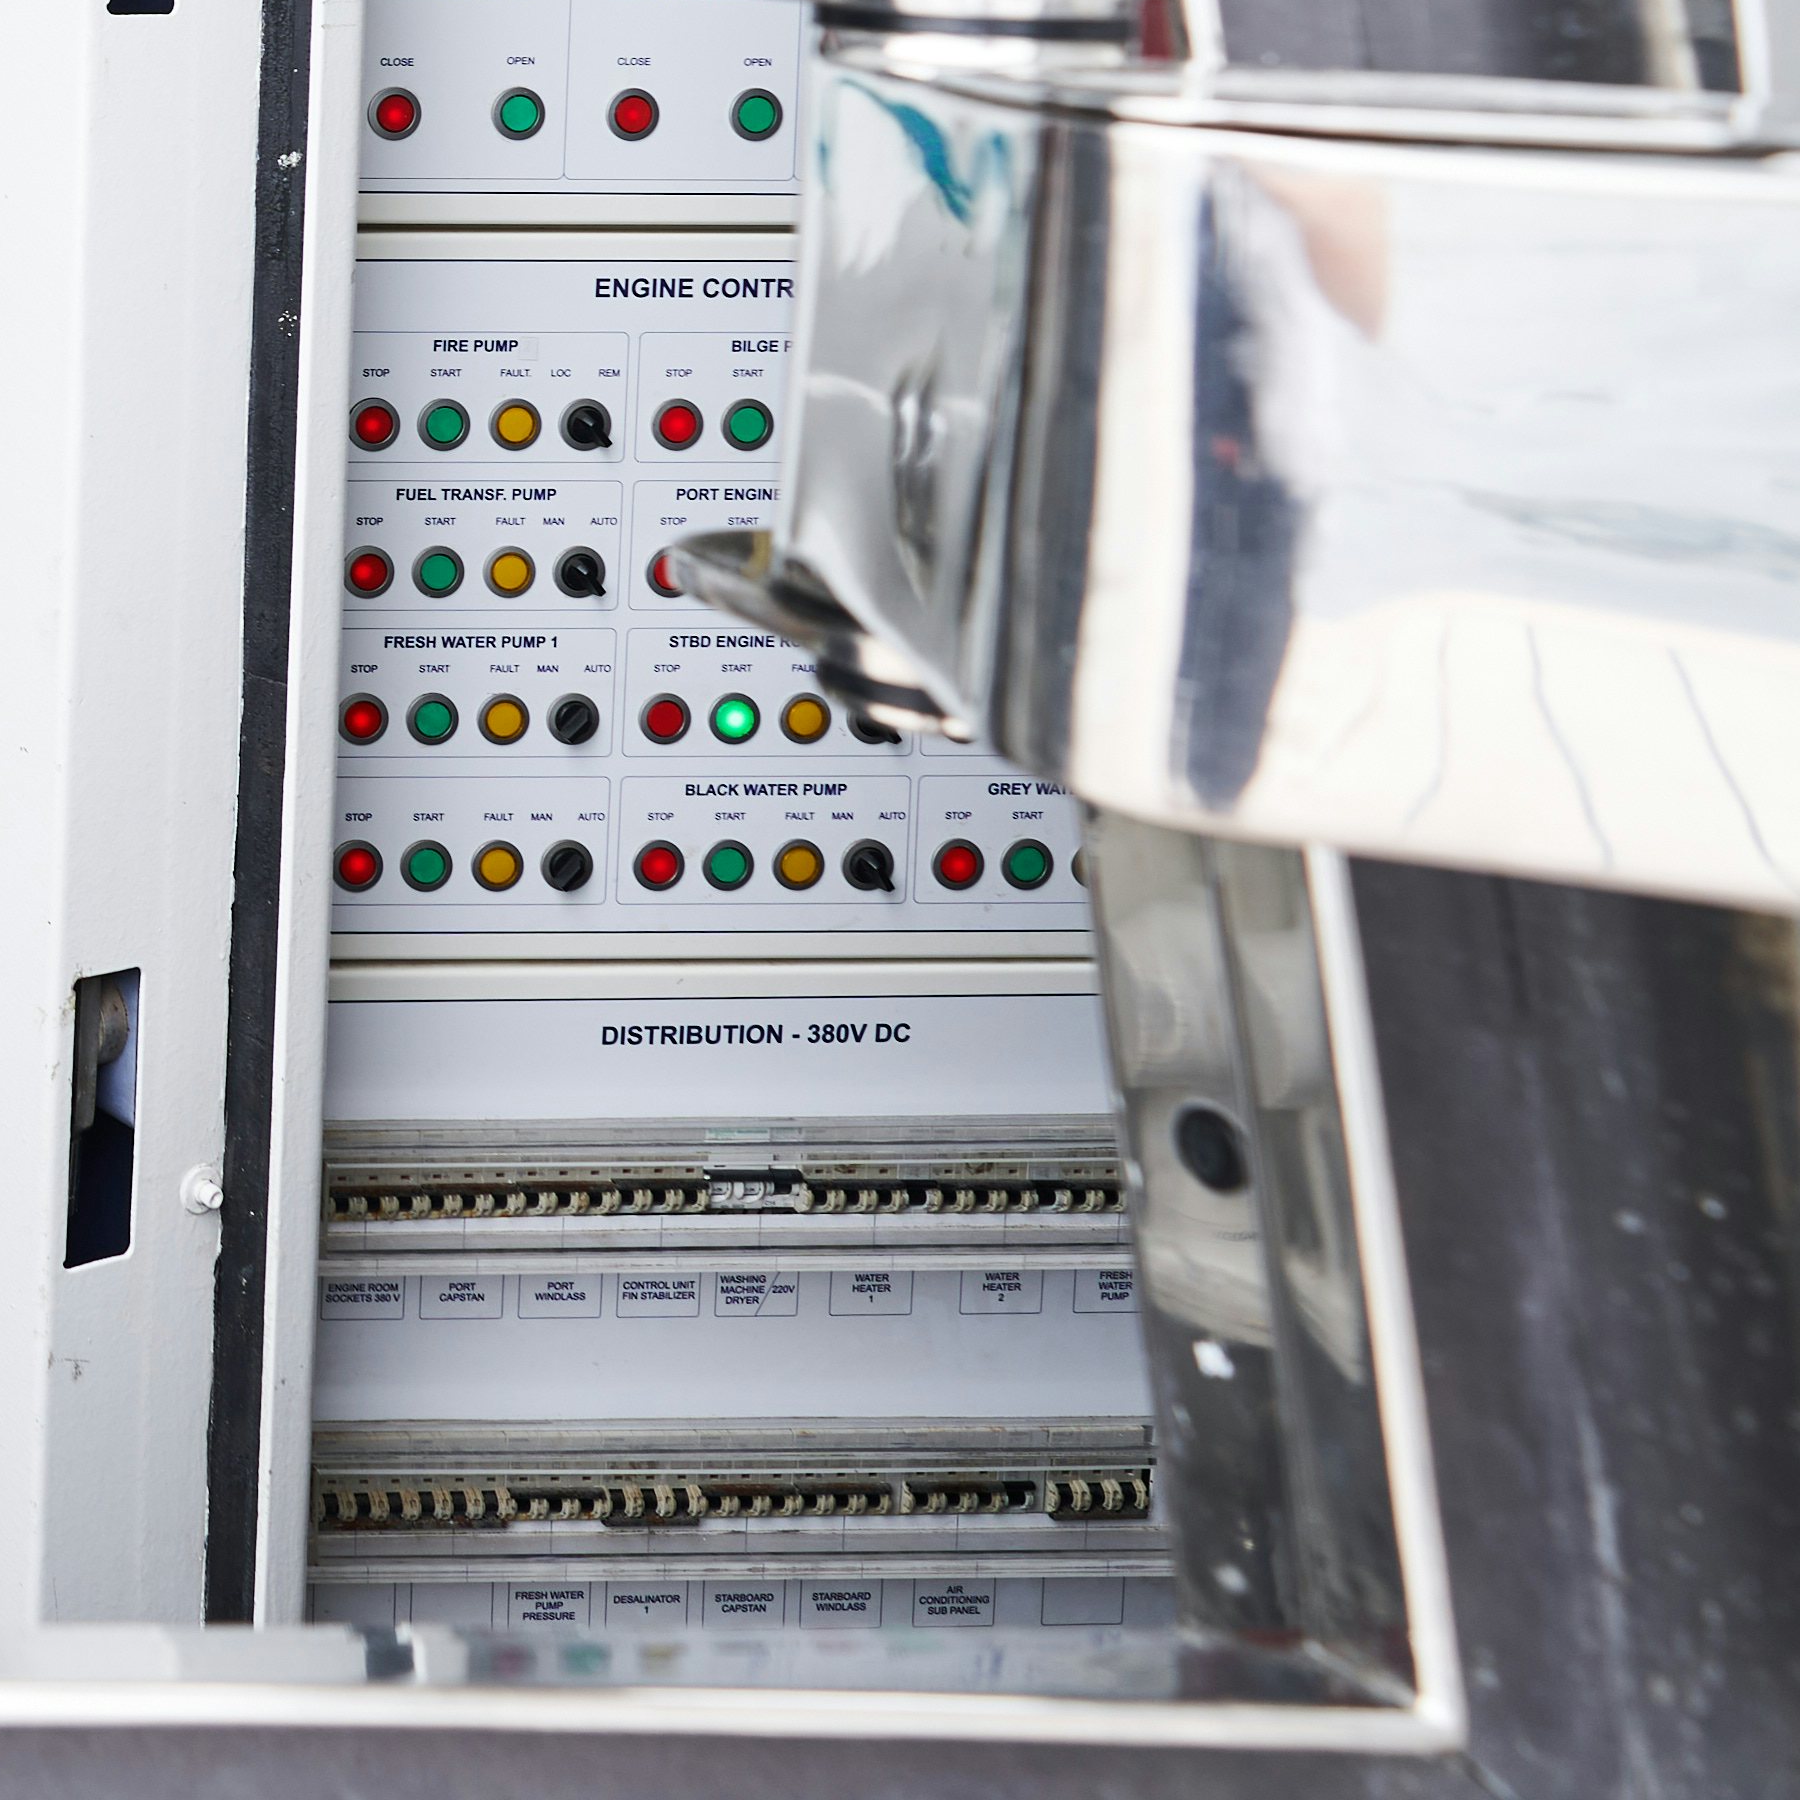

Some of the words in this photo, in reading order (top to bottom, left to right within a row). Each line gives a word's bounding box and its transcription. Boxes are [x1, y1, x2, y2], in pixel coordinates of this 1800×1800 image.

[379, 57, 415, 67] CLOSE
[506, 56, 535, 66] OPEN
[617, 57, 651, 66] CLOSE
[743, 57, 772, 67] OPEN
[595, 277, 694, 299] ENGINE
[433, 339, 469, 353] FIRE
[473, 339, 519, 353] PUMP
[731, 339, 780, 354] BILGE
[362, 368, 391, 378] STOP
[430, 368, 463, 378] START
[550, 368, 572, 378] LOC
[598, 368, 621, 378] REM
[396, 488, 437, 501] FUEL
[440, 488, 507, 501] TRANSF.
[511, 488, 557, 501] PUMP
[675, 488, 720, 502] PORT
[355, 516, 384, 526] STOP
[424, 516, 457, 526] START
[495, 516, 527, 526] FAULT
[542, 517, 565, 526] MAN
[590, 516, 618, 526] AUTO
[383, 635, 437, 649] FRESH
[440, 635, 497, 649] WATER
[501, 635, 547, 649] PUMP
[551, 635, 558, 648] 1
[669, 636, 711, 648] STBD
[716, 637, 775, 648] ENGINE
[350, 664, 379, 674] STOP
[418, 664, 450, 674] START
[489, 664, 521, 674] FAULT
[536, 664, 559, 673] MAN
[583, 664, 612, 673] AUTO
[685, 783, 739, 797] BLACK
[743, 783, 799, 796] WATER
[802, 783, 848, 796] PUMP
[988, 783, 1032, 795] GREY
[647, 812, 675, 821] STOP
[714, 812, 747, 821] START
[784, 811, 815, 821] FAULT
[831, 812, 854, 821] MAN
[878, 811, 907, 821] AUTO
[601, 1024, 784, 1046] DISTRIBUTION
[807, 1023, 868, 1044] 380V
[874, 1022, 911, 1043] DC
[719, 1272, 767, 1284] WASHING
[854, 1272, 890, 1283] WATER
[984, 1271, 1021, 1282] WATER
[1099, 1270, 1134, 1281] FRESH
[328, 1282, 366, 1293] ENGINE
[367, 1282, 399, 1293] ROOM
[448, 1281, 477, 1292] PORT
[546, 1281, 575, 1291] PORT
[622, 1280, 671, 1291] CONTROL
[672, 1280, 696, 1290] UNIT
[720, 1284, 766, 1295] MACHINE
[770, 1282, 796, 1294] 220V
[851, 1283, 892, 1293] HEATER
[982, 1282, 1022, 1292] HEATER
[1097, 1281, 1134, 1291] WATER
[324, 1292, 373, 1304] SOCKETS
[373, 1292, 392, 1303] 380
[392, 1292, 401, 1303] V
[438, 1292, 485, 1303] CAPSTAN
[534, 1291, 587, 1302] WINDLASS
[622, 1291, 639, 1301] FIN
[639, 1290, 696, 1301] STABILIZER
[725, 1295, 760, 1305] DRYER
[868, 1294, 874, 1303] 1
[997, 1292, 1005, 1302] 2
[1100, 1291, 1130, 1301] PUMP
[945, 1584, 964, 1595] AIR
[514, 1590, 549, 1601] FRESH
[549, 1590, 585, 1600] WATER
[612, 1594, 681, 1605] DESALINATOR
[714, 1592, 775, 1603] STARBOARD
[811, 1591, 872, 1602] STARBOARD
[918, 1593, 990, 1606] CONDITIONING
[534, 1600, 564, 1611] PUMP
[643, 1605, 650, 1615] 1
[721, 1601, 767, 1614] CAPSTAN
[815, 1601, 867, 1612] WINDLASS
[927, 1605, 948, 1616] SUB
[949, 1605, 981, 1615] PANEL
[522, 1611, 576, 1621] PRESSURE
